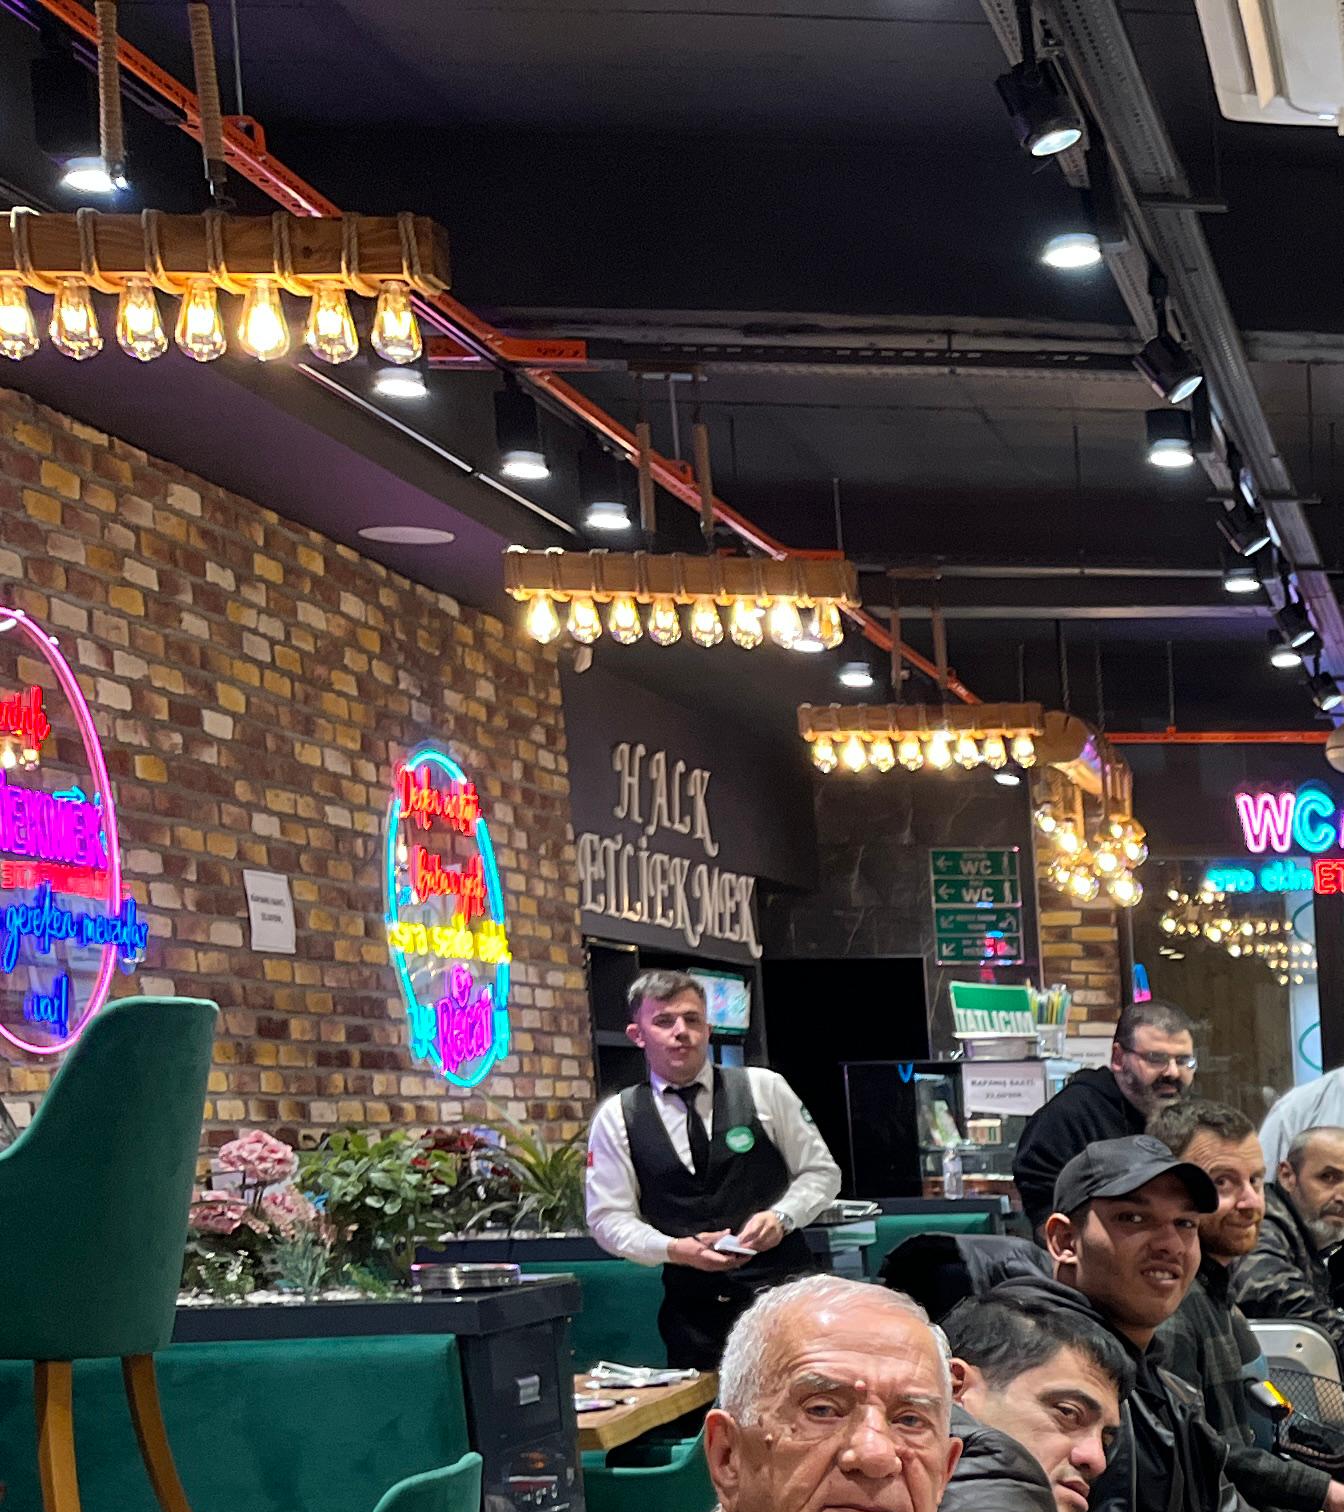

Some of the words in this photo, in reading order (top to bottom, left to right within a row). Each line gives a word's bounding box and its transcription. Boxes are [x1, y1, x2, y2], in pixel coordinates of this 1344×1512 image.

[612, 742, 719, 857] HALK
[1236, 791, 1336, 853] WC
[576, 832, 763, 959] ETLİEKMEK
[959, 860, 992, 875] WC
[961, 887, 995, 902] WC
